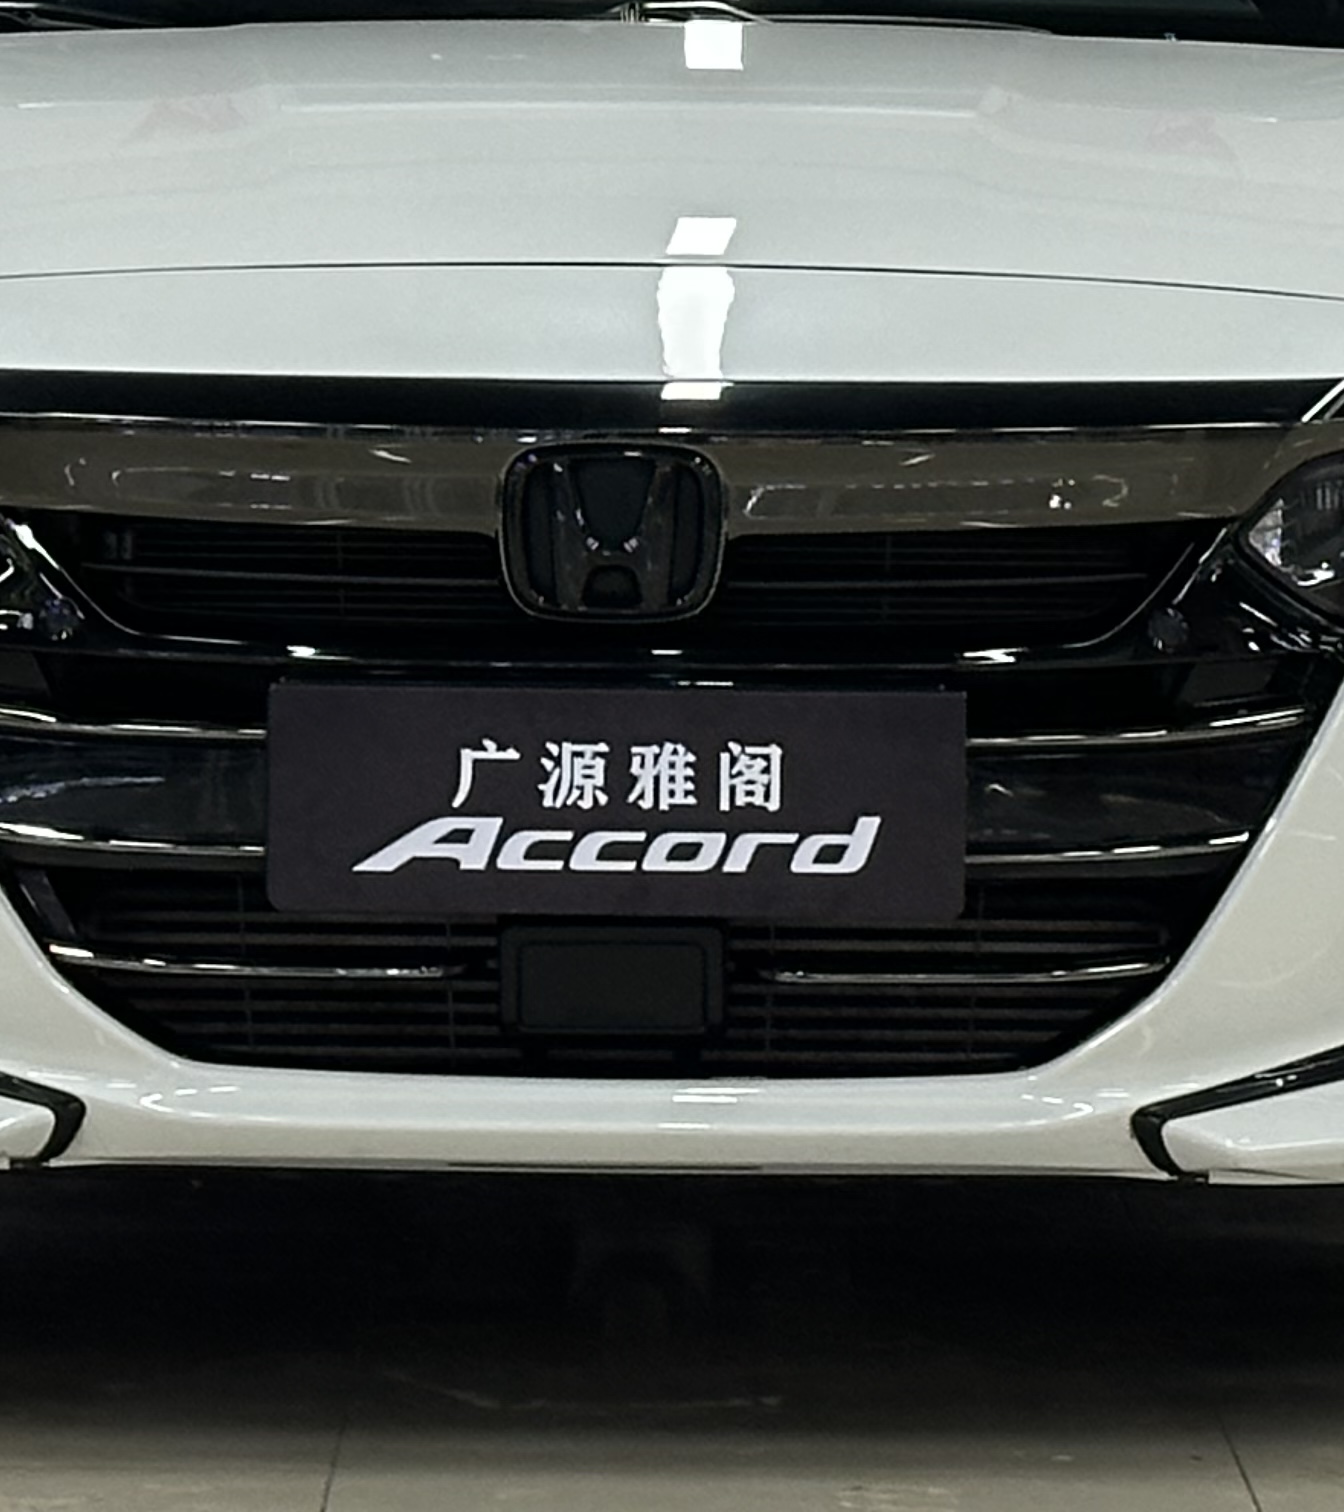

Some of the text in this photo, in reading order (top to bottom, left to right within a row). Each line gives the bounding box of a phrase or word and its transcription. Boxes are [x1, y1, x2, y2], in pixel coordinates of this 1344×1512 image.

[452, 739, 784, 812] 广源雅阁
[353, 815, 882, 874] Accord
